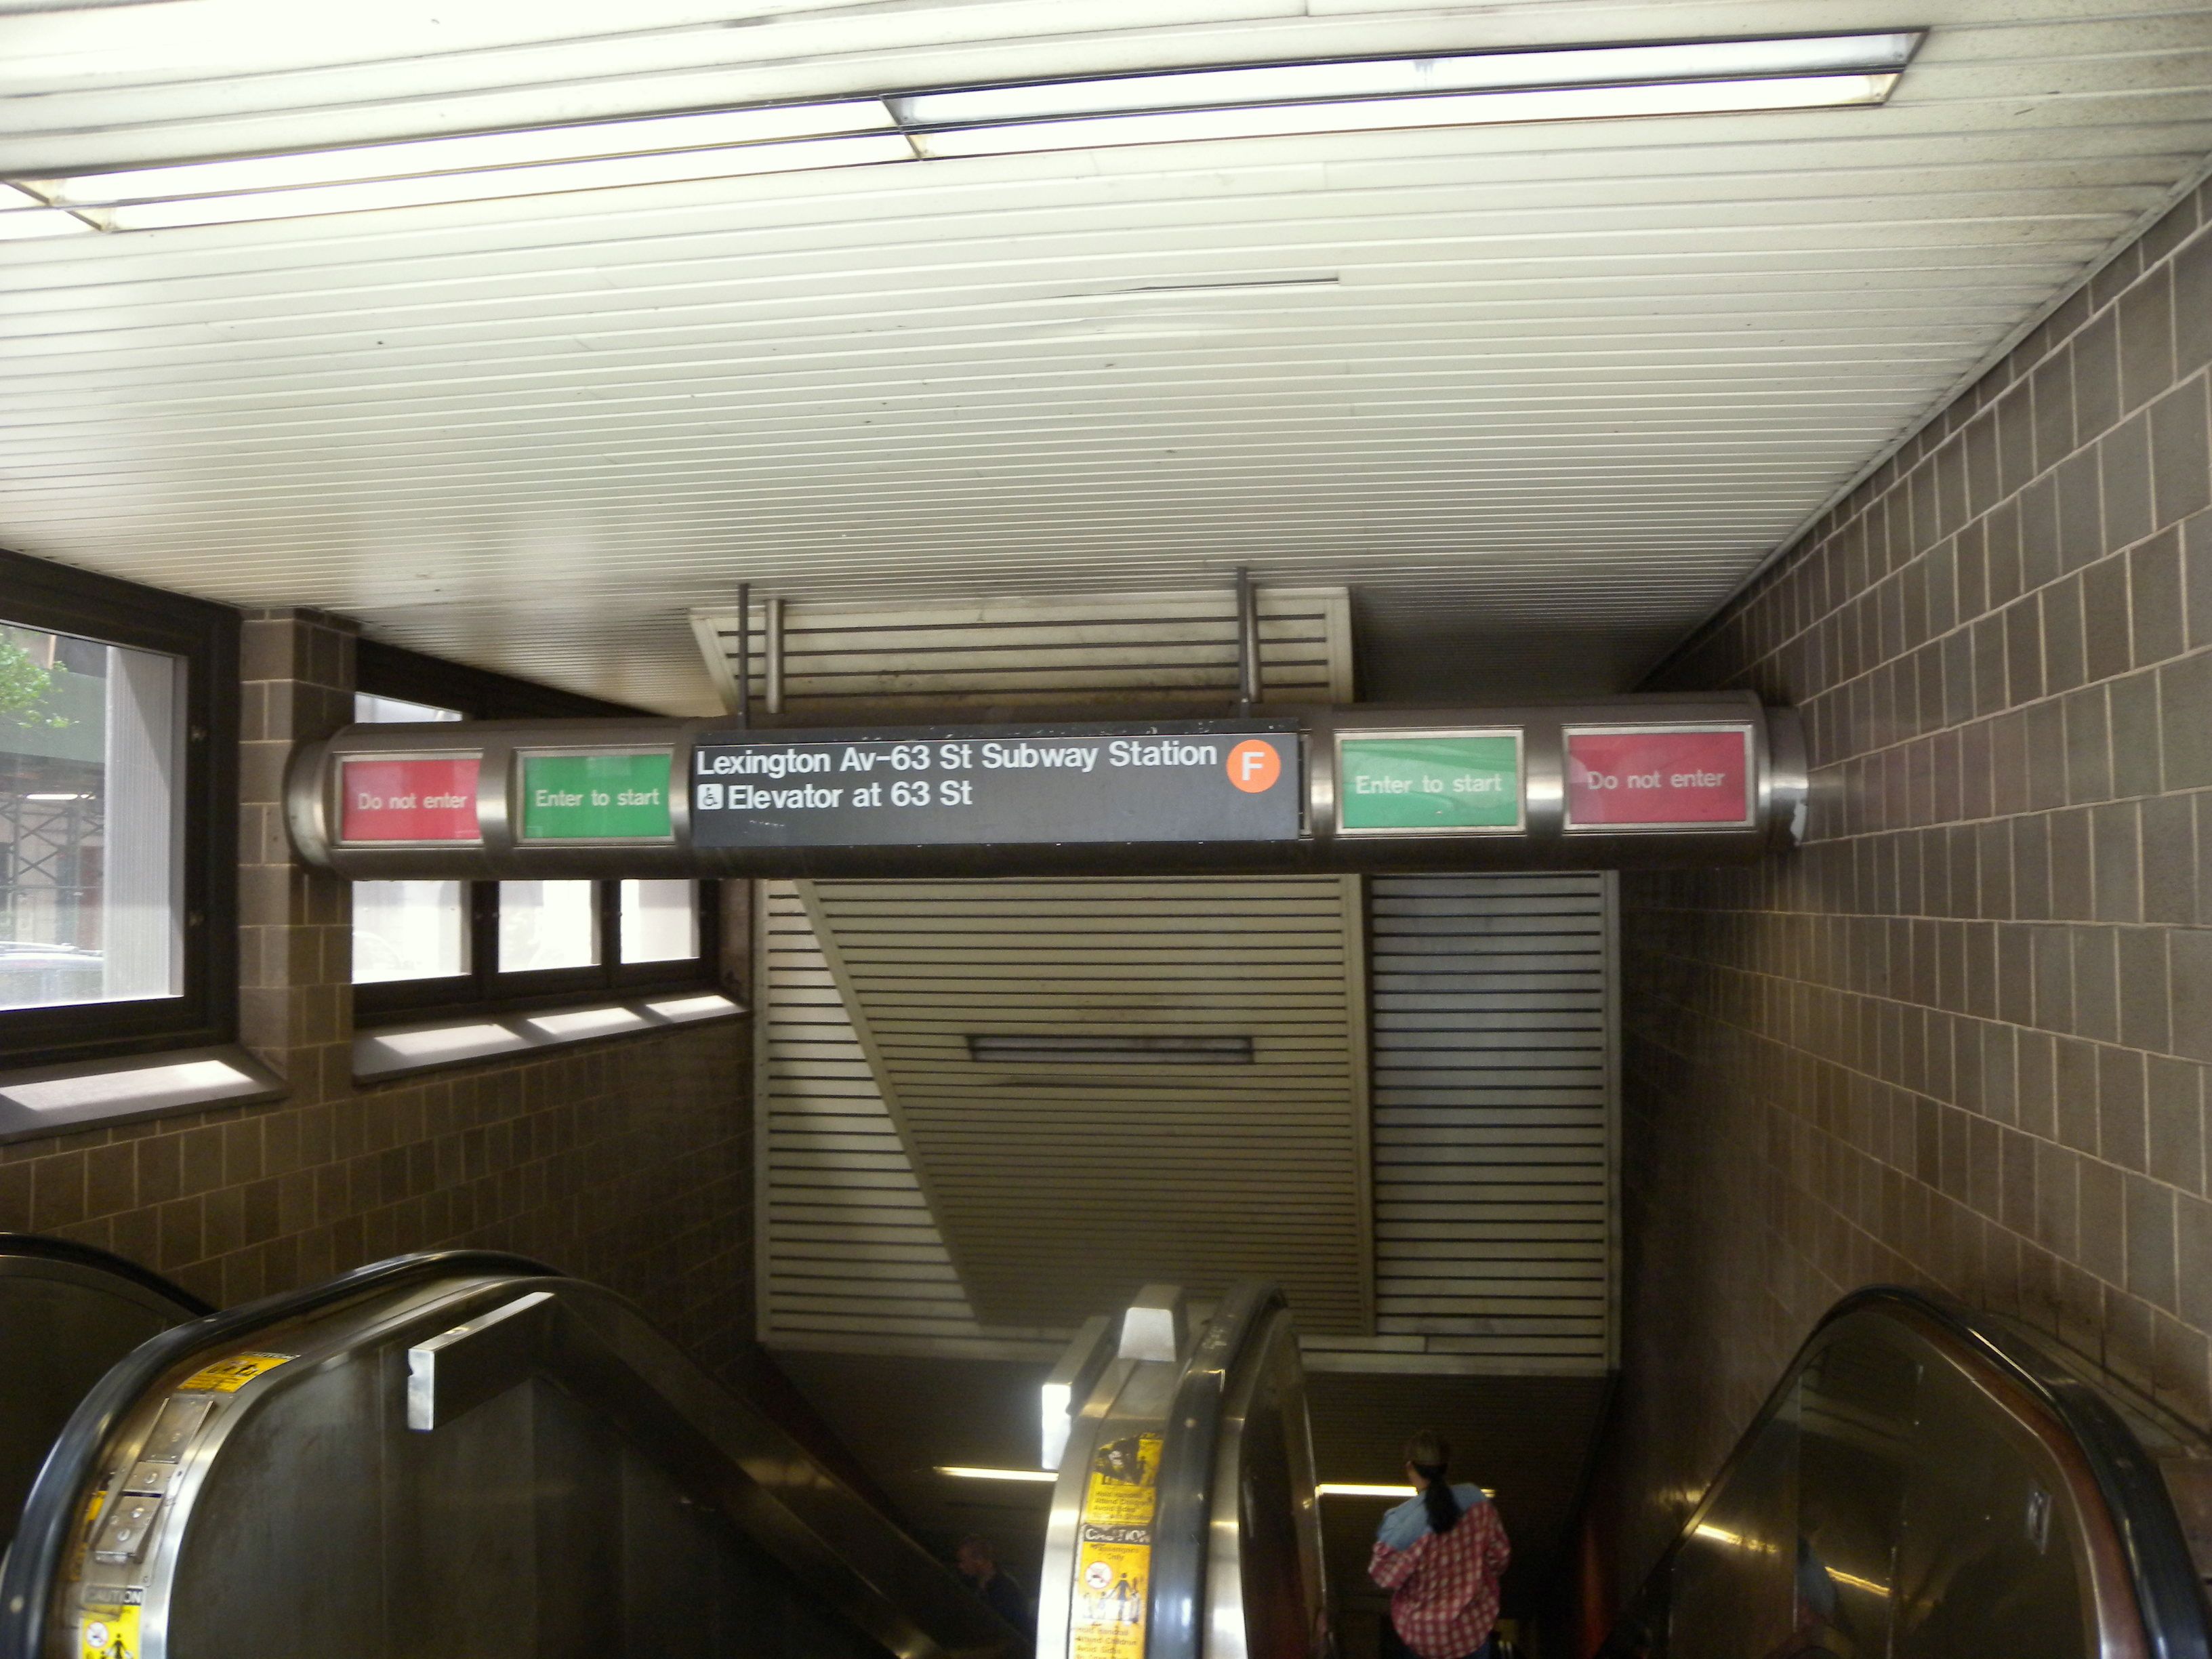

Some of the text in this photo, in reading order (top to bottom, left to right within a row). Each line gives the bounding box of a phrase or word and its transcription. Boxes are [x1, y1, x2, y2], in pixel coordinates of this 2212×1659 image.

[697, 749, 832, 779] Lexington
[939, 744, 973, 769] St
[982, 743, 1099, 772] Subway
[1108, 740, 1218, 767] Station
[1242, 752, 1265, 781] F
[1355, 774, 1502, 796] Enter to start
[1587, 770, 1725, 790] Do not enter
[357, 792, 468, 809] Do not enter
[535, 788, 660, 806] Enter to start
[729, 780, 973, 809] Elevator at 63 St
